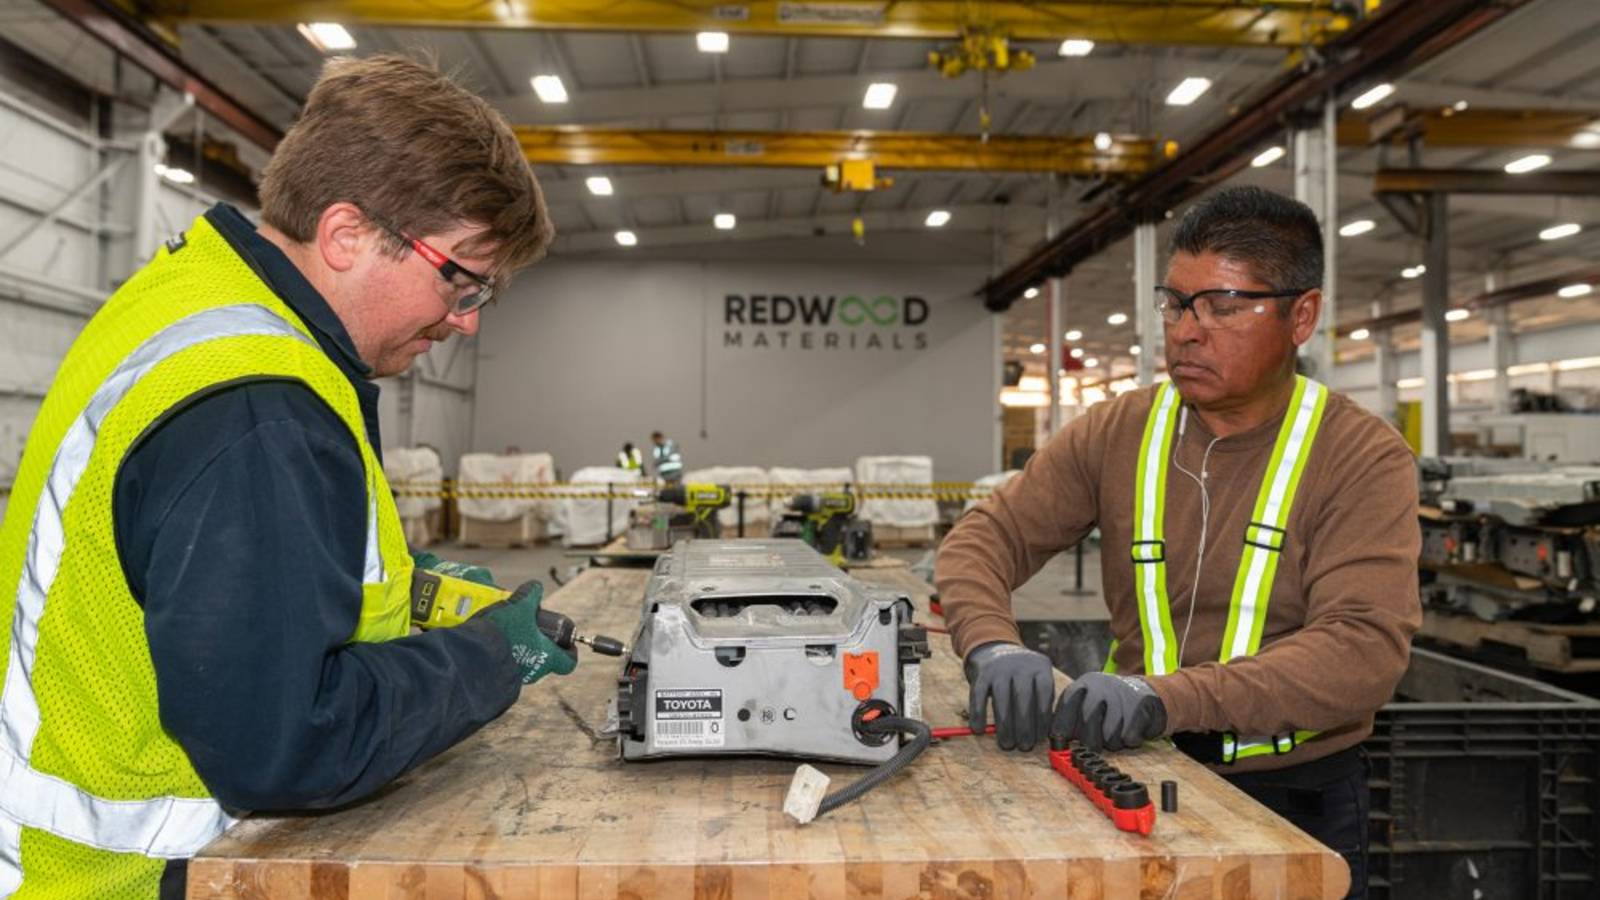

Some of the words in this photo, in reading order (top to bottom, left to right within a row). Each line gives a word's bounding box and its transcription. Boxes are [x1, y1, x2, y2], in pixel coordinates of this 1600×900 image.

[724, 294, 930, 326] REDWOOD
[723, 331, 929, 350] MATERIALS
[663, 699, 712, 710] TOYOTA
